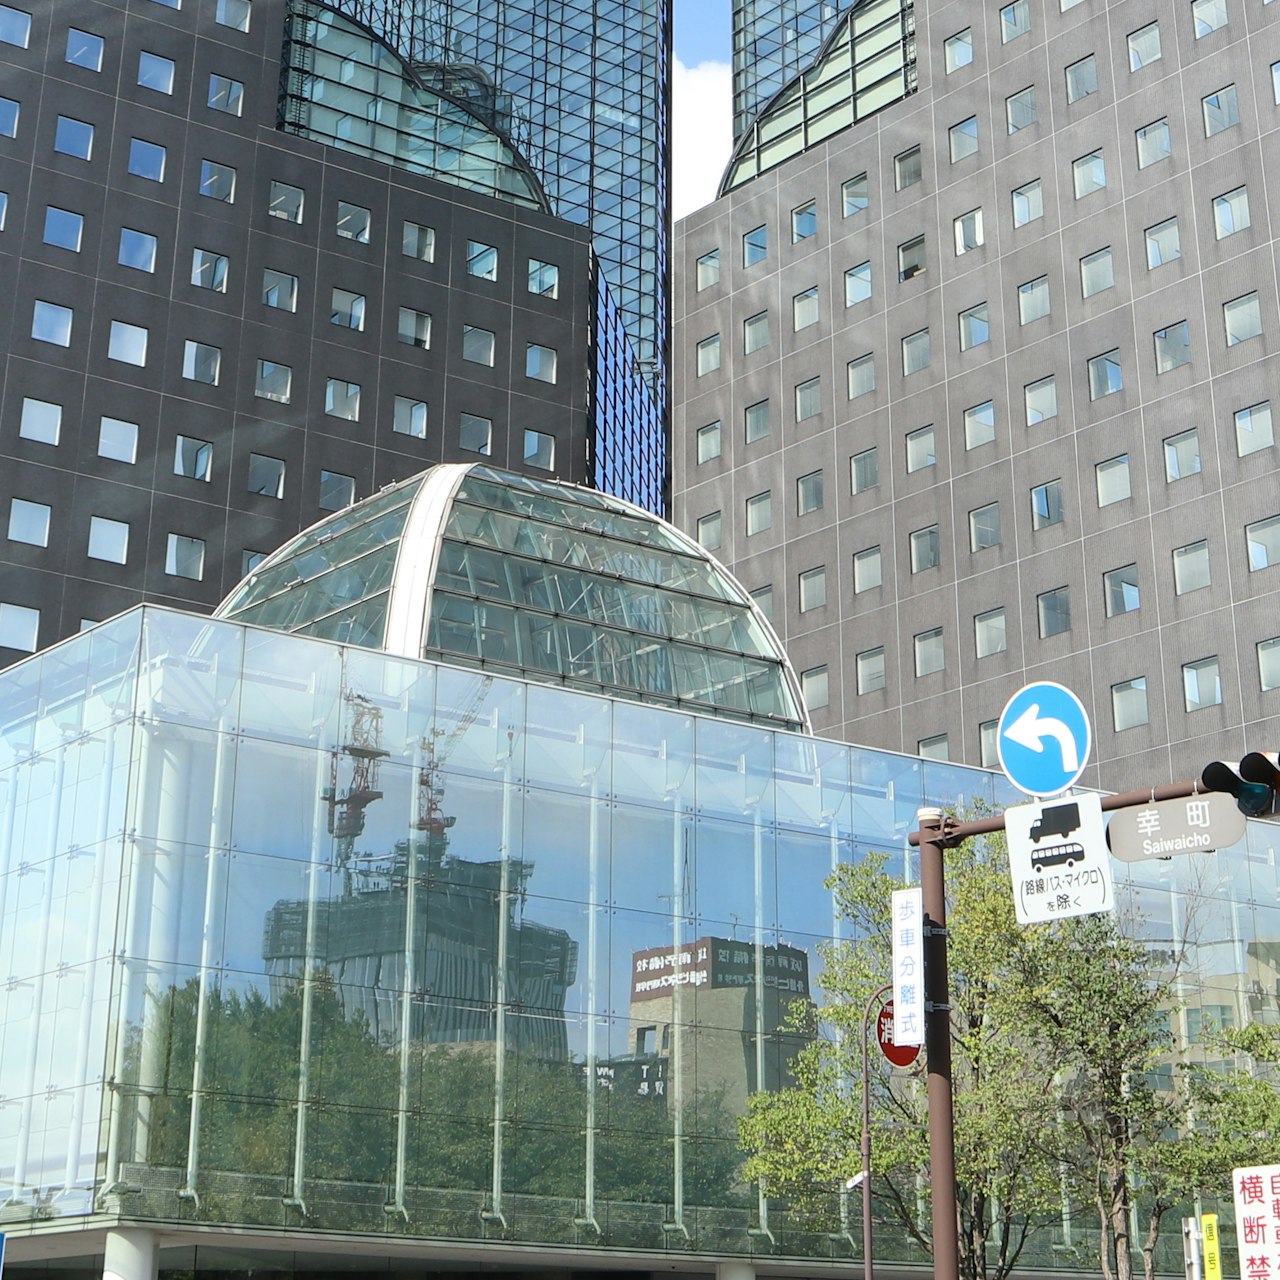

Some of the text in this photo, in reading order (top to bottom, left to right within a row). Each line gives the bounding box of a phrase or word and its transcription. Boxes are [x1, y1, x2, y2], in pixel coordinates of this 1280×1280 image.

[1143, 833, 1211, 855] Saiwaicho
[898, 900, 917, 1034] 歩車分離式
